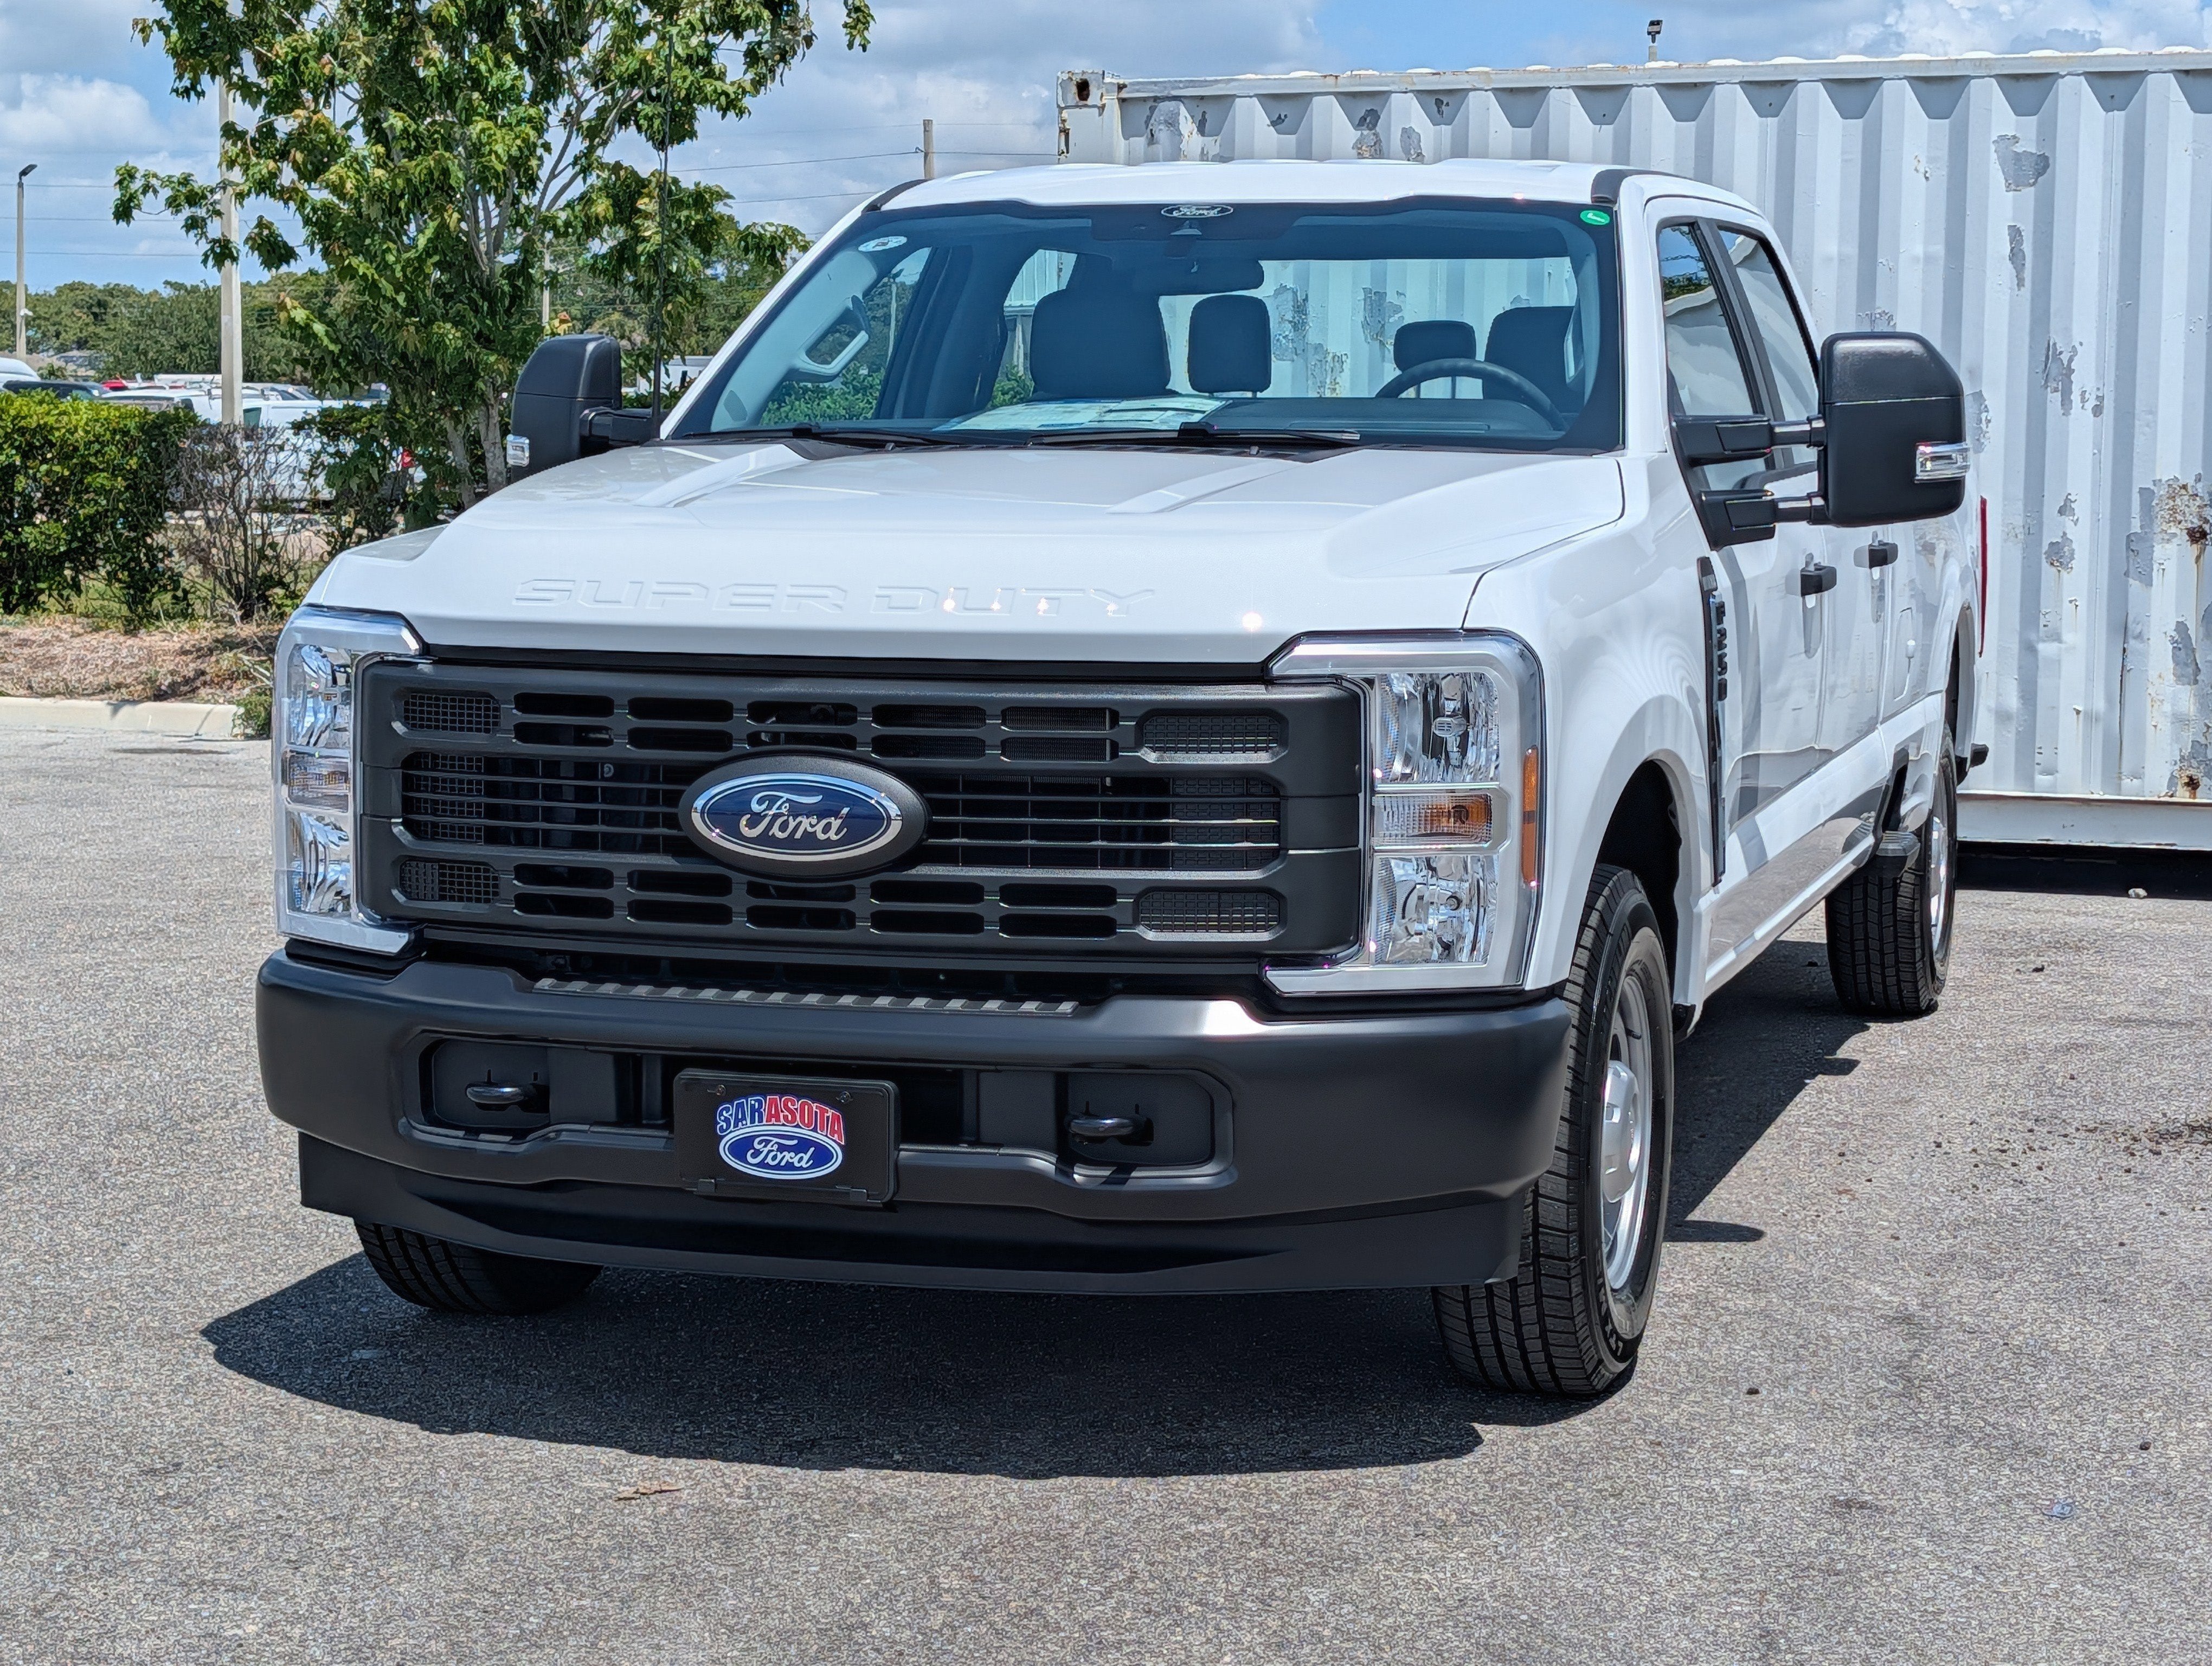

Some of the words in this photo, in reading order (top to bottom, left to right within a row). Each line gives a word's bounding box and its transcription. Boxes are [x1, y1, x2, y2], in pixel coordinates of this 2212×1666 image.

[1173, 206, 1222, 216] Ford
[511, 578, 848, 614] SUPER
[869, 585, 1156, 618] DUTY
[740, 791, 851, 841] Ford
[716, 1094, 846, 1146] SARASOTA
[746, 1136, 814, 1168] Ford
